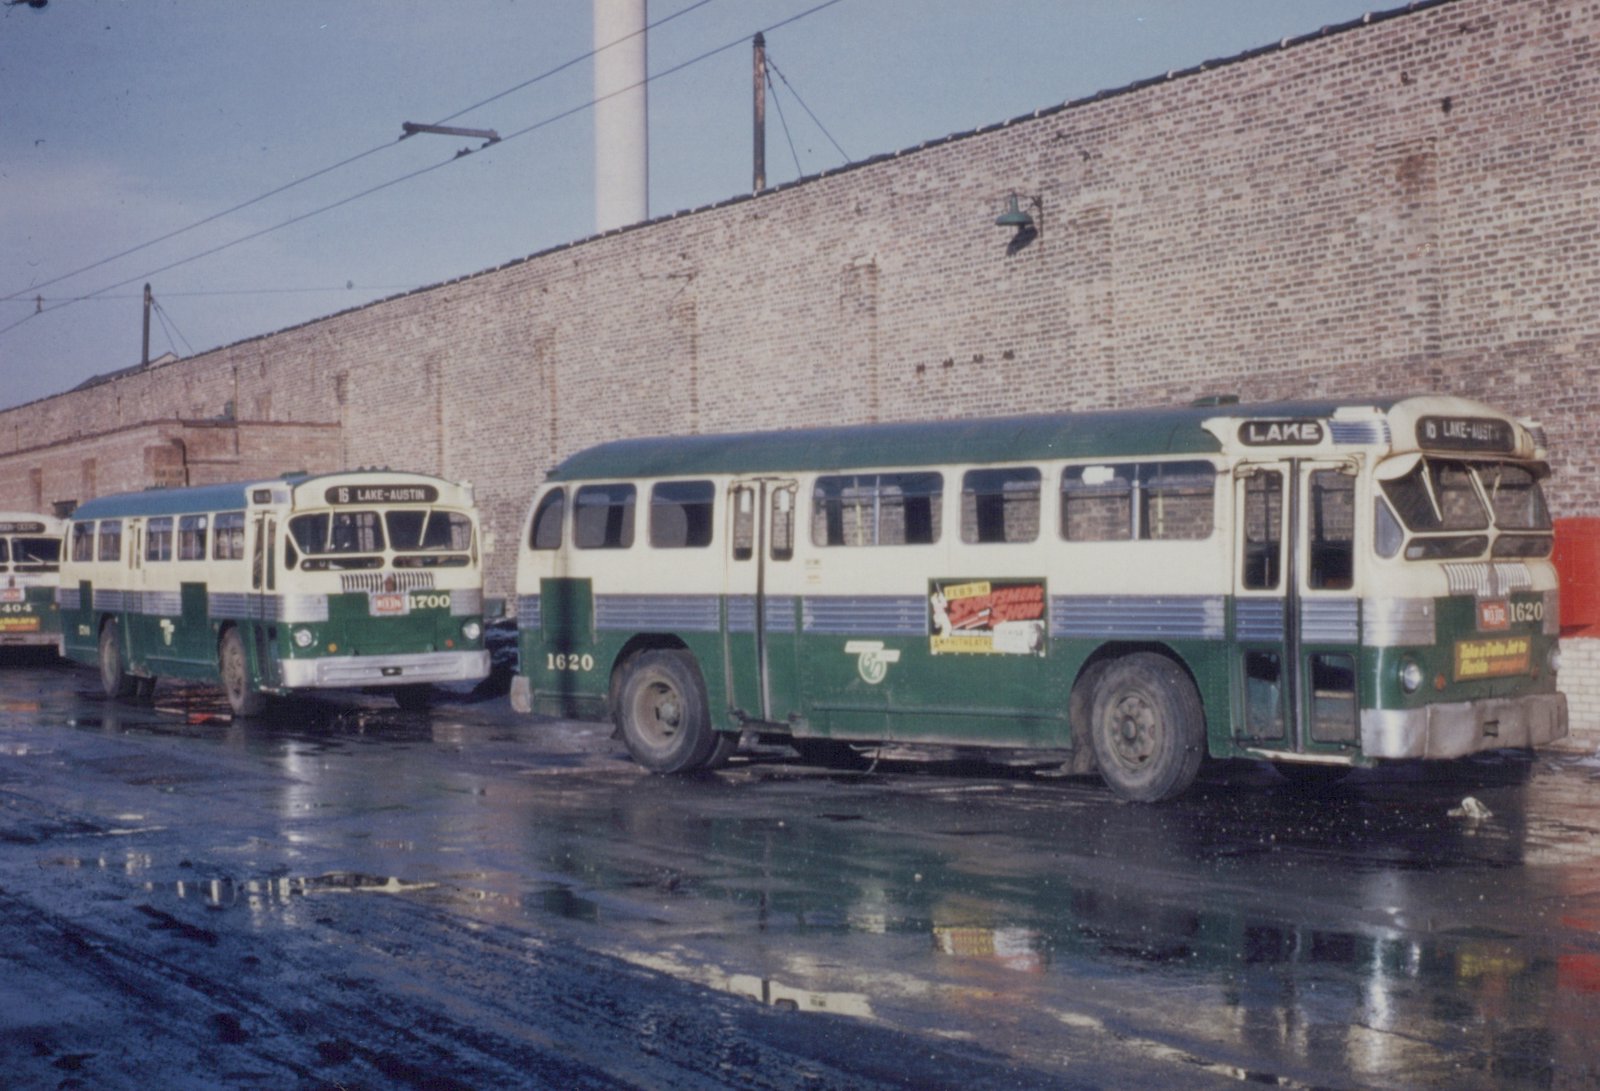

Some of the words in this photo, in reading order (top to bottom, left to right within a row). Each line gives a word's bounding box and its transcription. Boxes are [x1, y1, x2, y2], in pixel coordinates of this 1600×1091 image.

[1249, 423, 1320, 442] LAKE
[338, 488, 349, 503] 16
[357, 489, 426, 501] LAKE-AUSTIN
[409, 594, 450, 609] 1700
[1510, 602, 1543, 622] 1620
[547, 653, 594, 671] 1620
